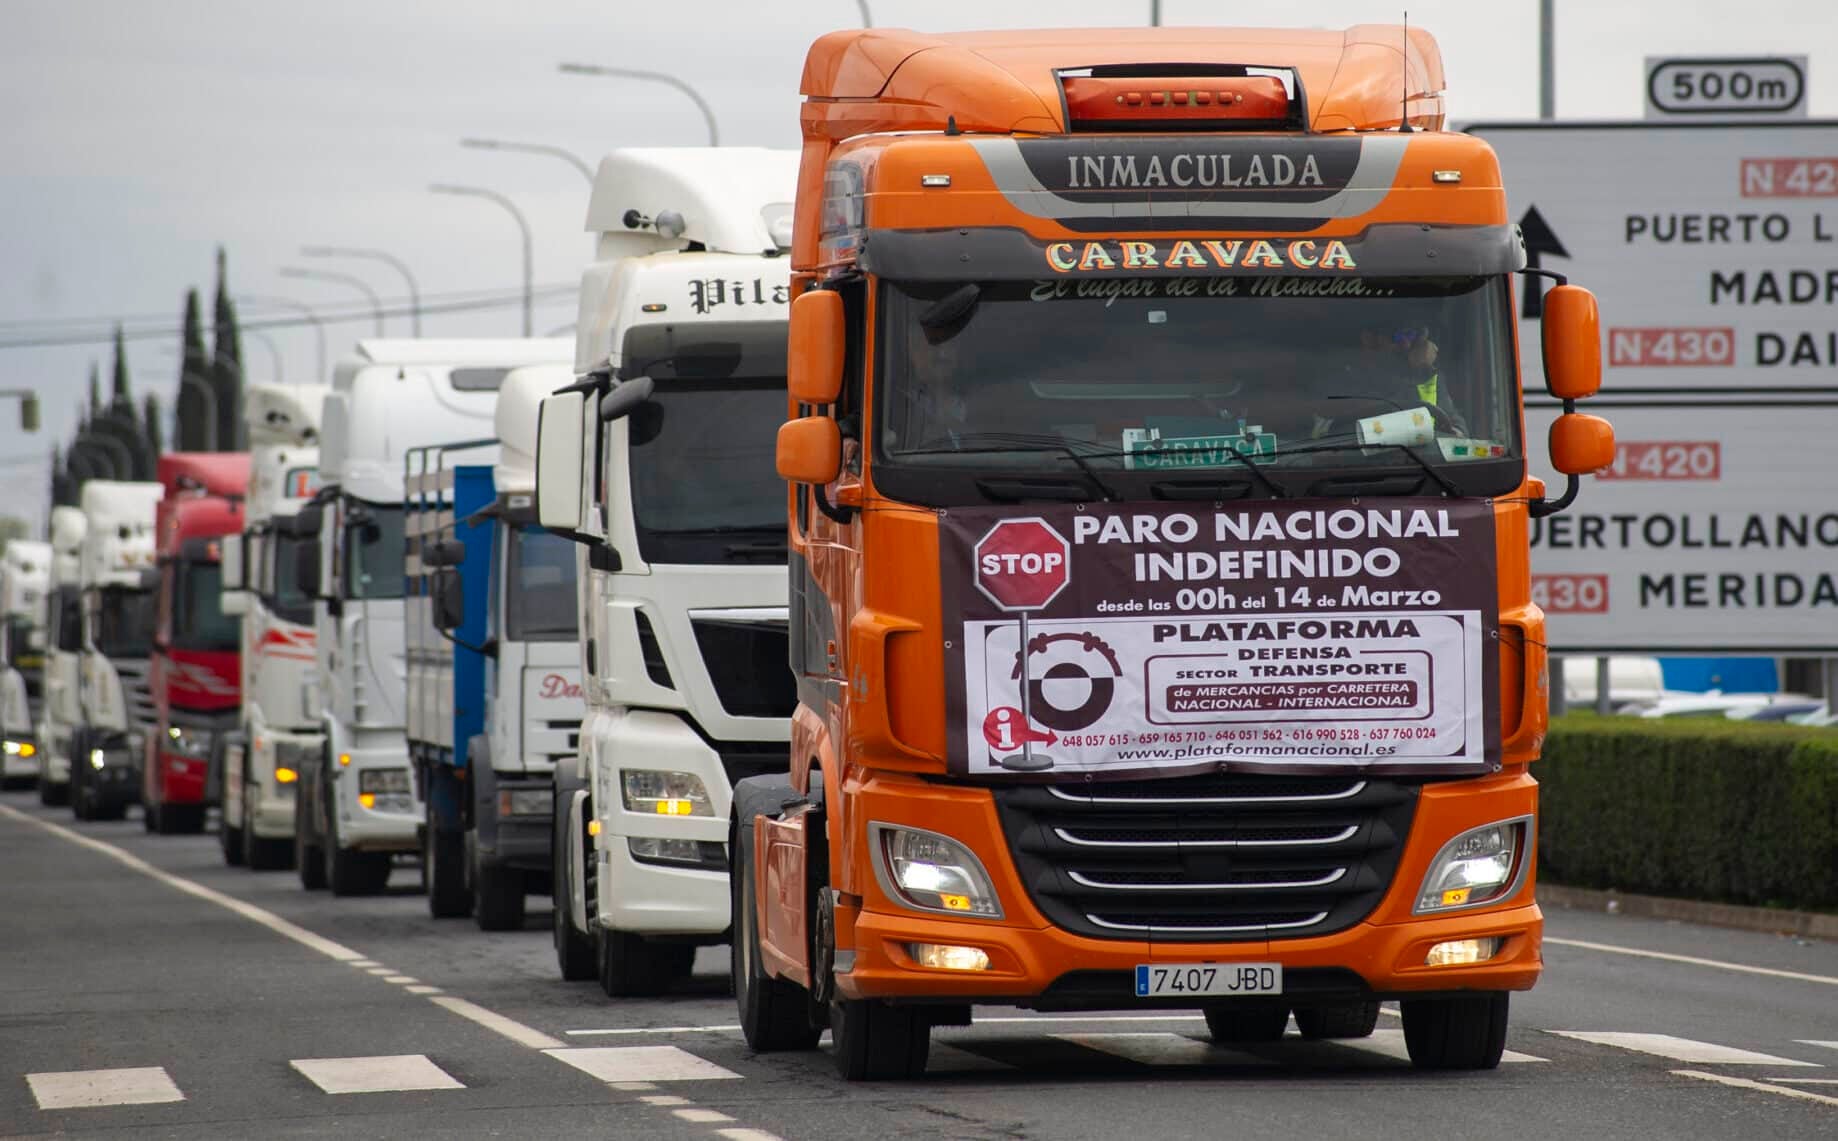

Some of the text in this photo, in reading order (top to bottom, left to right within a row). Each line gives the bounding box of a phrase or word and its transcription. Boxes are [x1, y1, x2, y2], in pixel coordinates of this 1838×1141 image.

[1672, 72, 1787, 101] 500m
[1068, 154, 1324, 188] INMACULADA
[1625, 213, 1790, 243] PUERTO
[1046, 240, 1357, 273] CARAVACA
[1030, 279, 1068, 302] El
[1077, 278, 1157, 307] lugar
[1165, 276, 1199, 297] de
[1207, 277, 1238, 297] la
[1073, 509, 1460, 545] PARO NACIONAL
[982, 552, 1063, 575] STOP
[1134, 547, 1401, 582] INDEFINIDO
[1097, 585, 1441, 612] desde las 00h del 14 de Marzo
[1639, 572, 1838, 608] MERIDA
[1152, 619, 1421, 643] PLATAFORMA
[1238, 646, 1352, 661] DEFENSA
[1176, 663, 1407, 679] SECTOR TRANSPORTE
[1173, 682, 1410, 698] de MERCANCIAS por CARRETERA
[1174, 697, 1262, 710] NACIONAL
[1278, 695, 1411, 709] INTERNACIONAL
[1062, 735, 1083, 748] 648
[1086, 735, 1105, 747] 057
[1109, 734, 1129, 746] 615
[1139, 733, 1159, 745] 659
[1163, 732, 1182, 744] 165
[1186, 731, 1206, 743] 710
[1215, 730, 1236, 741] 646
[1239, 730, 1258, 740] 051
[1263, 729, 1282, 741] 562
[1292, 729, 1313, 740] 616
[1316, 728, 1337, 740] 990
[1340, 728, 1360, 740] 528
[1369, 728, 1389, 740] 637
[1392, 728, 1413, 739] 760
[1416, 727, 1436, 739] 024
[1118, 743, 1397, 760] www.plataformanacional.es
[1154, 968, 1217, 992] 7407
[1228, 967, 1274, 991] JBD
